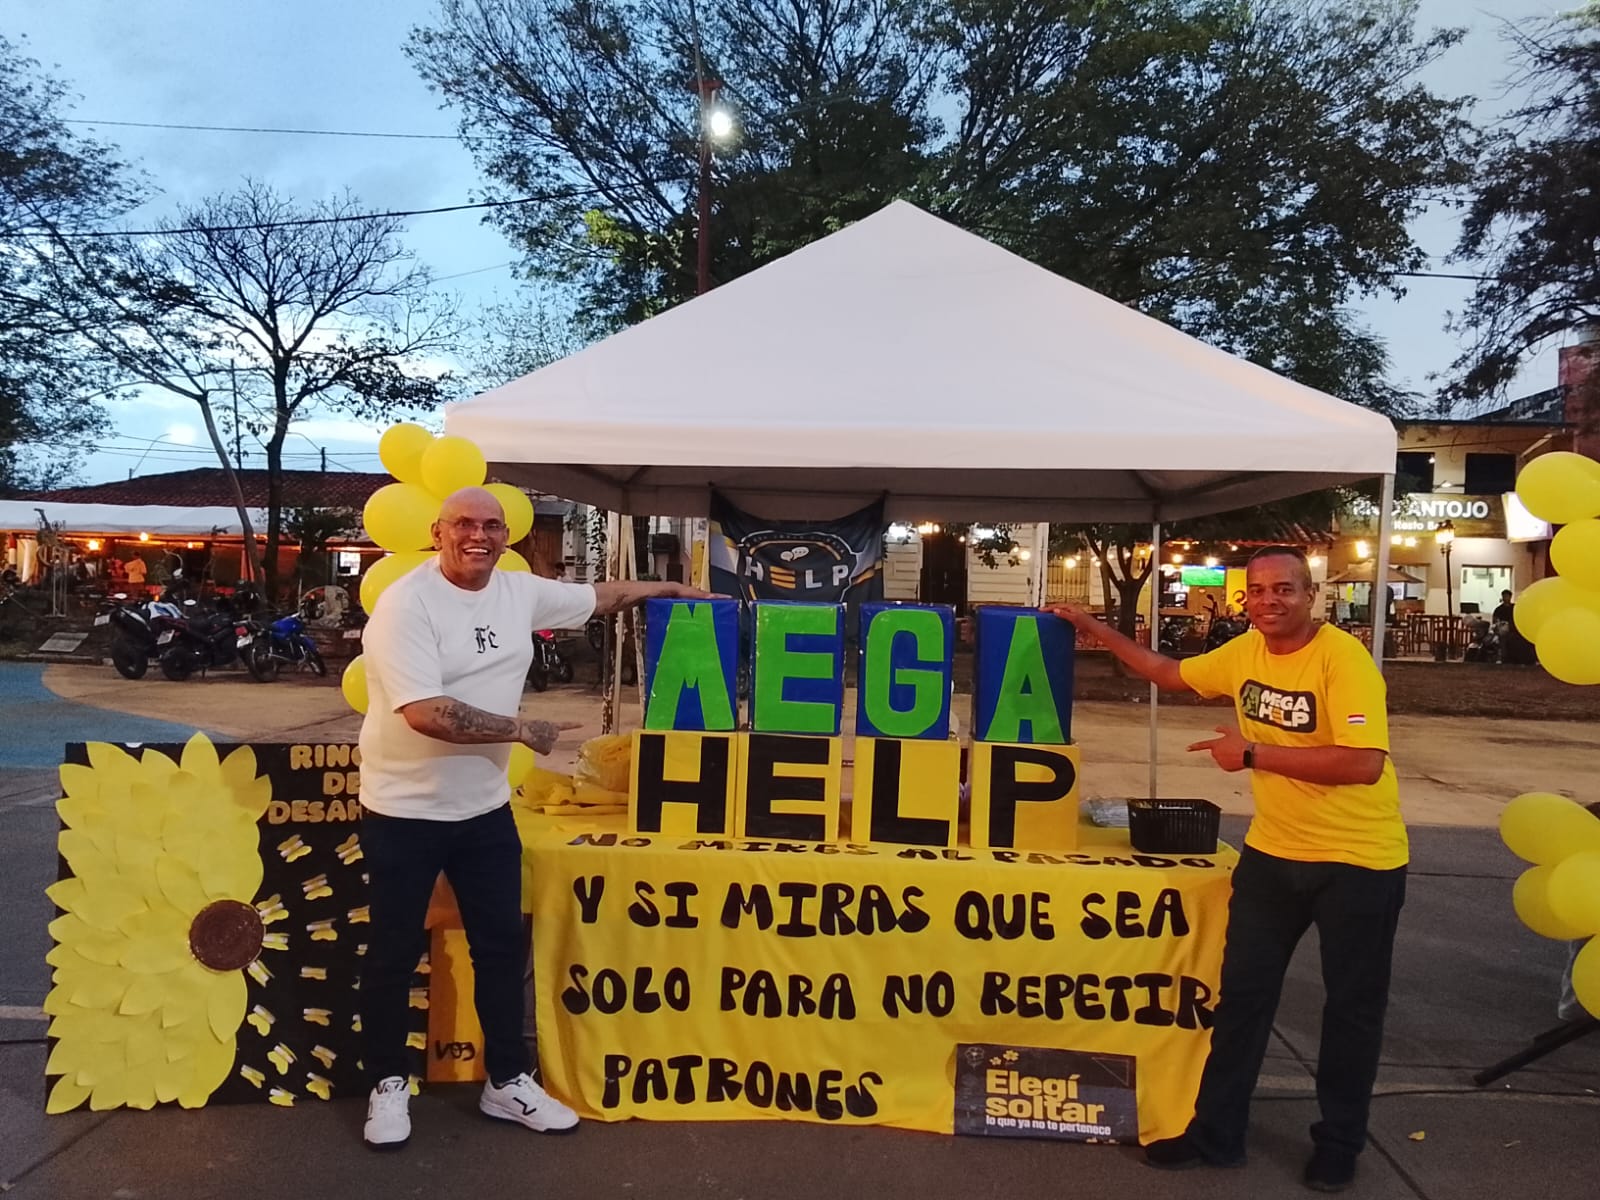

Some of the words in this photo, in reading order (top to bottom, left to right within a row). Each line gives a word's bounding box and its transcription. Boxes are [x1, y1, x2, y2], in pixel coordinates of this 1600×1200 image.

[1406, 500, 1490, 519] ANTOJO
[745, 556, 849, 589] HELP
[645, 602, 1066, 744] MEGA
[1258, 703, 1310, 727] HELP
[1260, 690, 1311, 712] MEGA
[636, 734, 1077, 848] HELP
[567, 833, 652, 848] NO
[677, 839, 880, 855] MIRES
[897, 849, 976, 861] AL
[992, 850, 1216, 868] PASADO
[573, 875, 605, 924] Y
[628, 881, 699, 929] SI
[720, 881, 931, 938] MIRAS
[954, 890, 1055, 941] QUE
[1080, 888, 1190, 939] SEA
[561, 964, 691, 1015] SOLO
[720, 966, 857, 1020] PARA
[882, 970, 955, 1018] NO
[980, 971, 1215, 1030] REPETIR
[602, 1054, 883, 1120] PATRONES
[986, 1069, 1080, 1102] Elegí
[985, 1095, 1105, 1124] soltar
[986, 1115, 996, 1126] lo
[997, 1117, 1017, 1128] que
[1017, 1119, 1031, 1129] ya
[1032, 1120, 1045, 1130] no
[1047, 1120, 1058, 1131] te
[1059, 1122, 1112, 1136] pertenece
